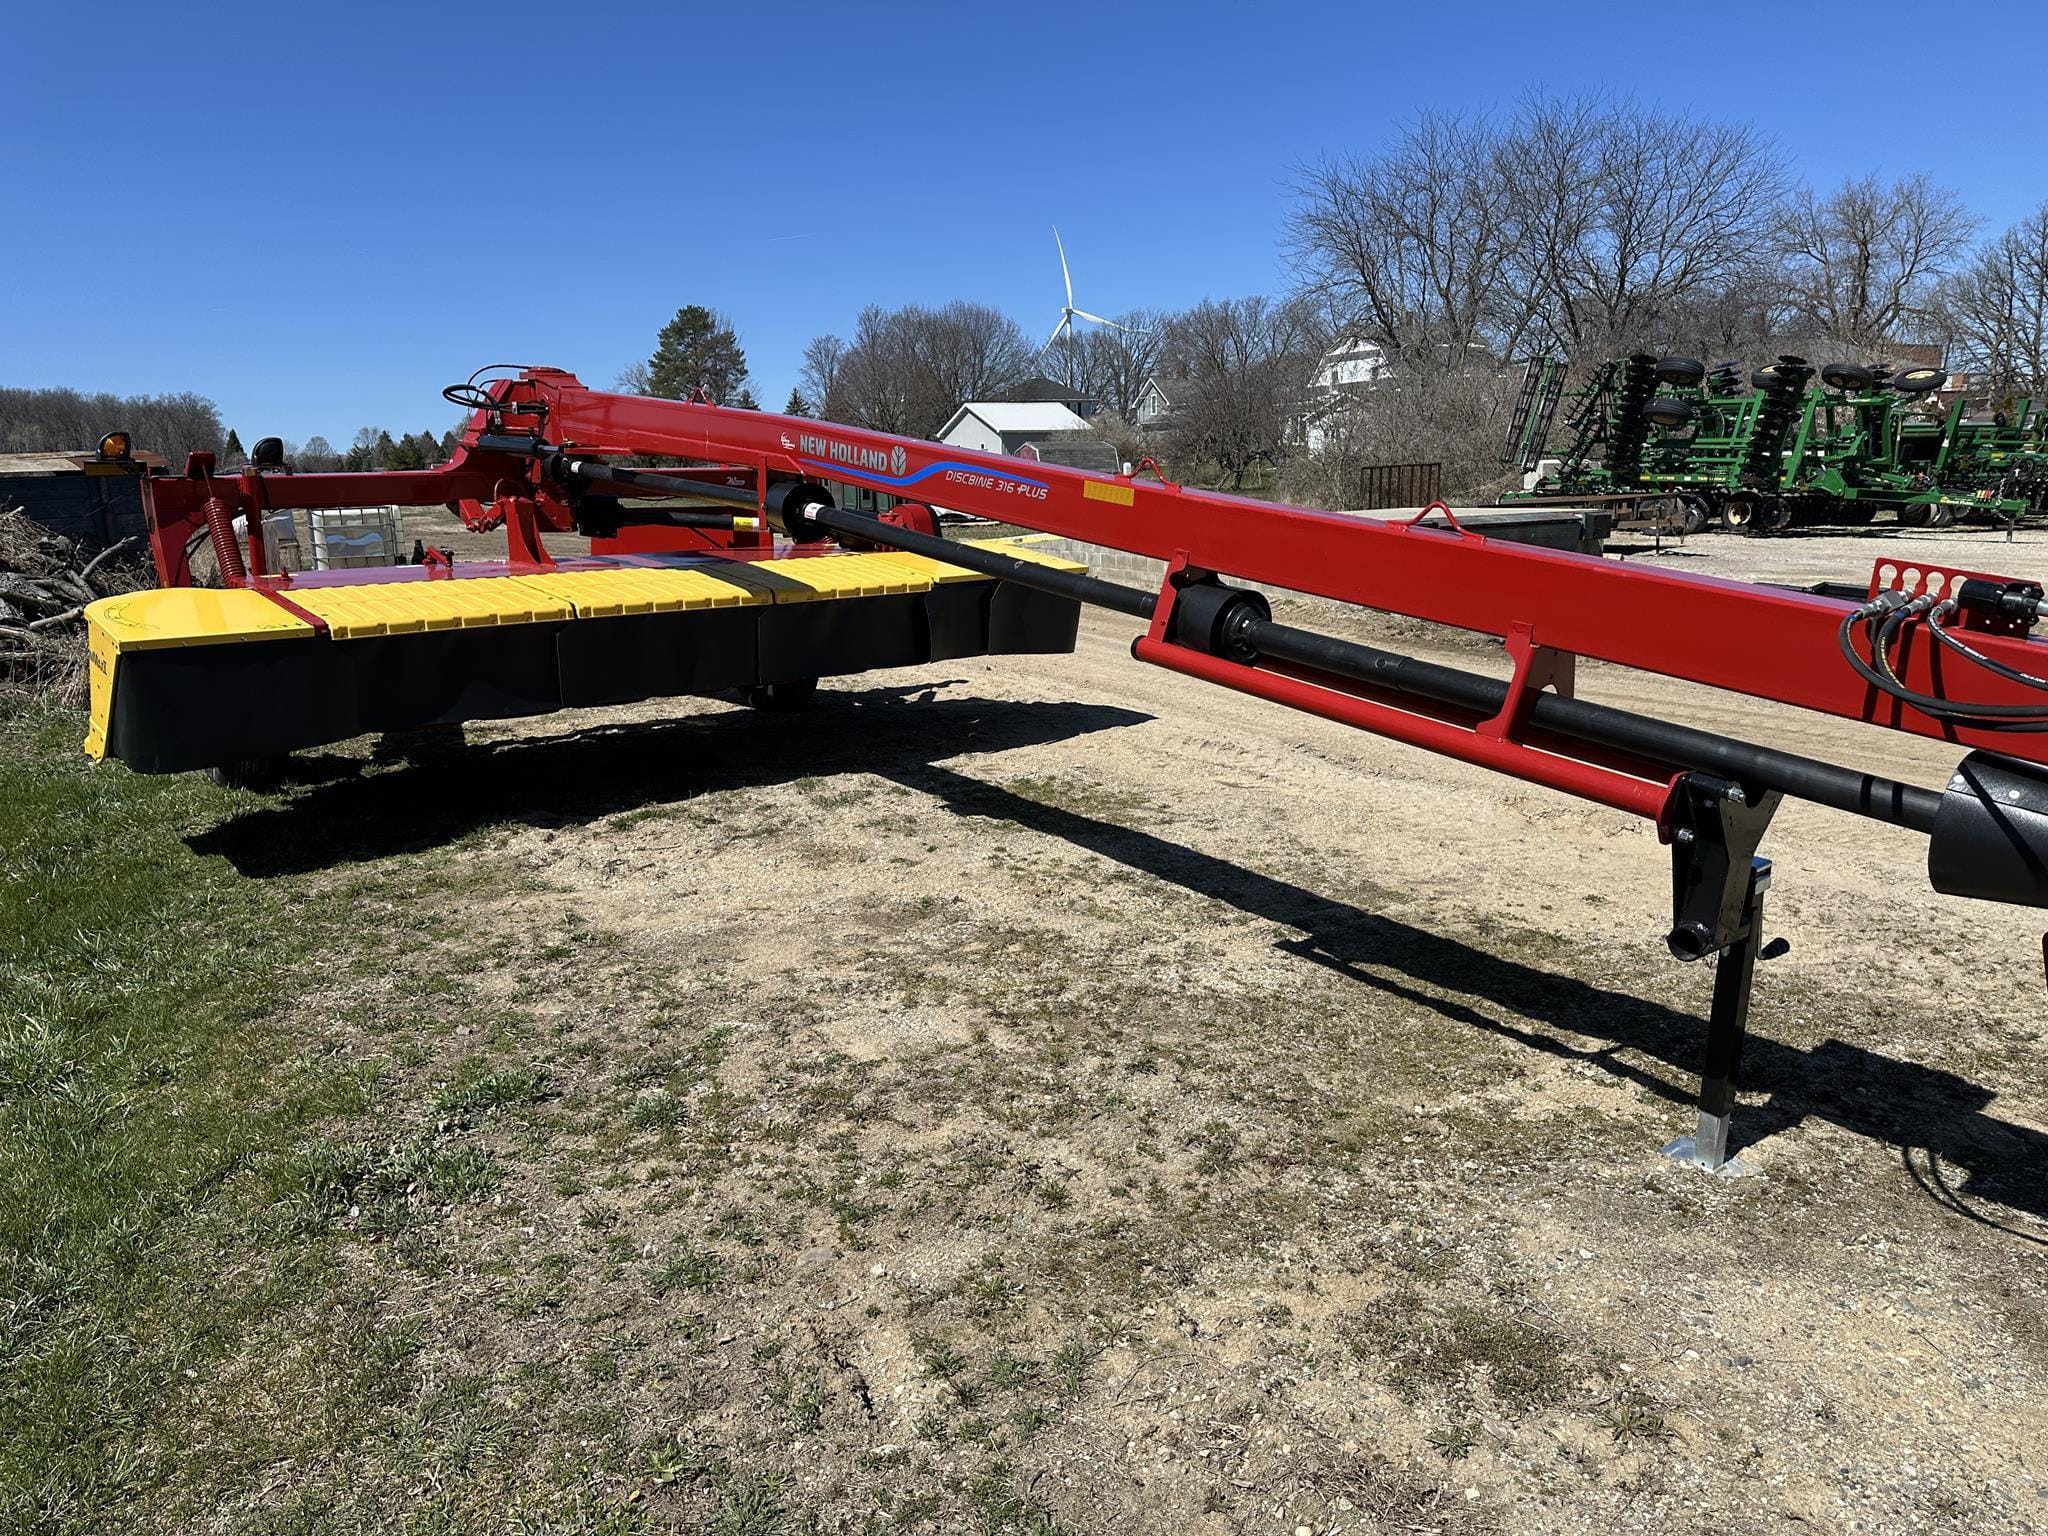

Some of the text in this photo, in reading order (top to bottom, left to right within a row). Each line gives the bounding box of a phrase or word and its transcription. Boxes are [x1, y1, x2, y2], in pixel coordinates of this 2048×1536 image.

[799, 433, 827, 458] NEW
[829, 440, 888, 472] HOLLAND
[945, 470, 995, 489] DISCBINE
[995, 480, 1015, 494] 316
